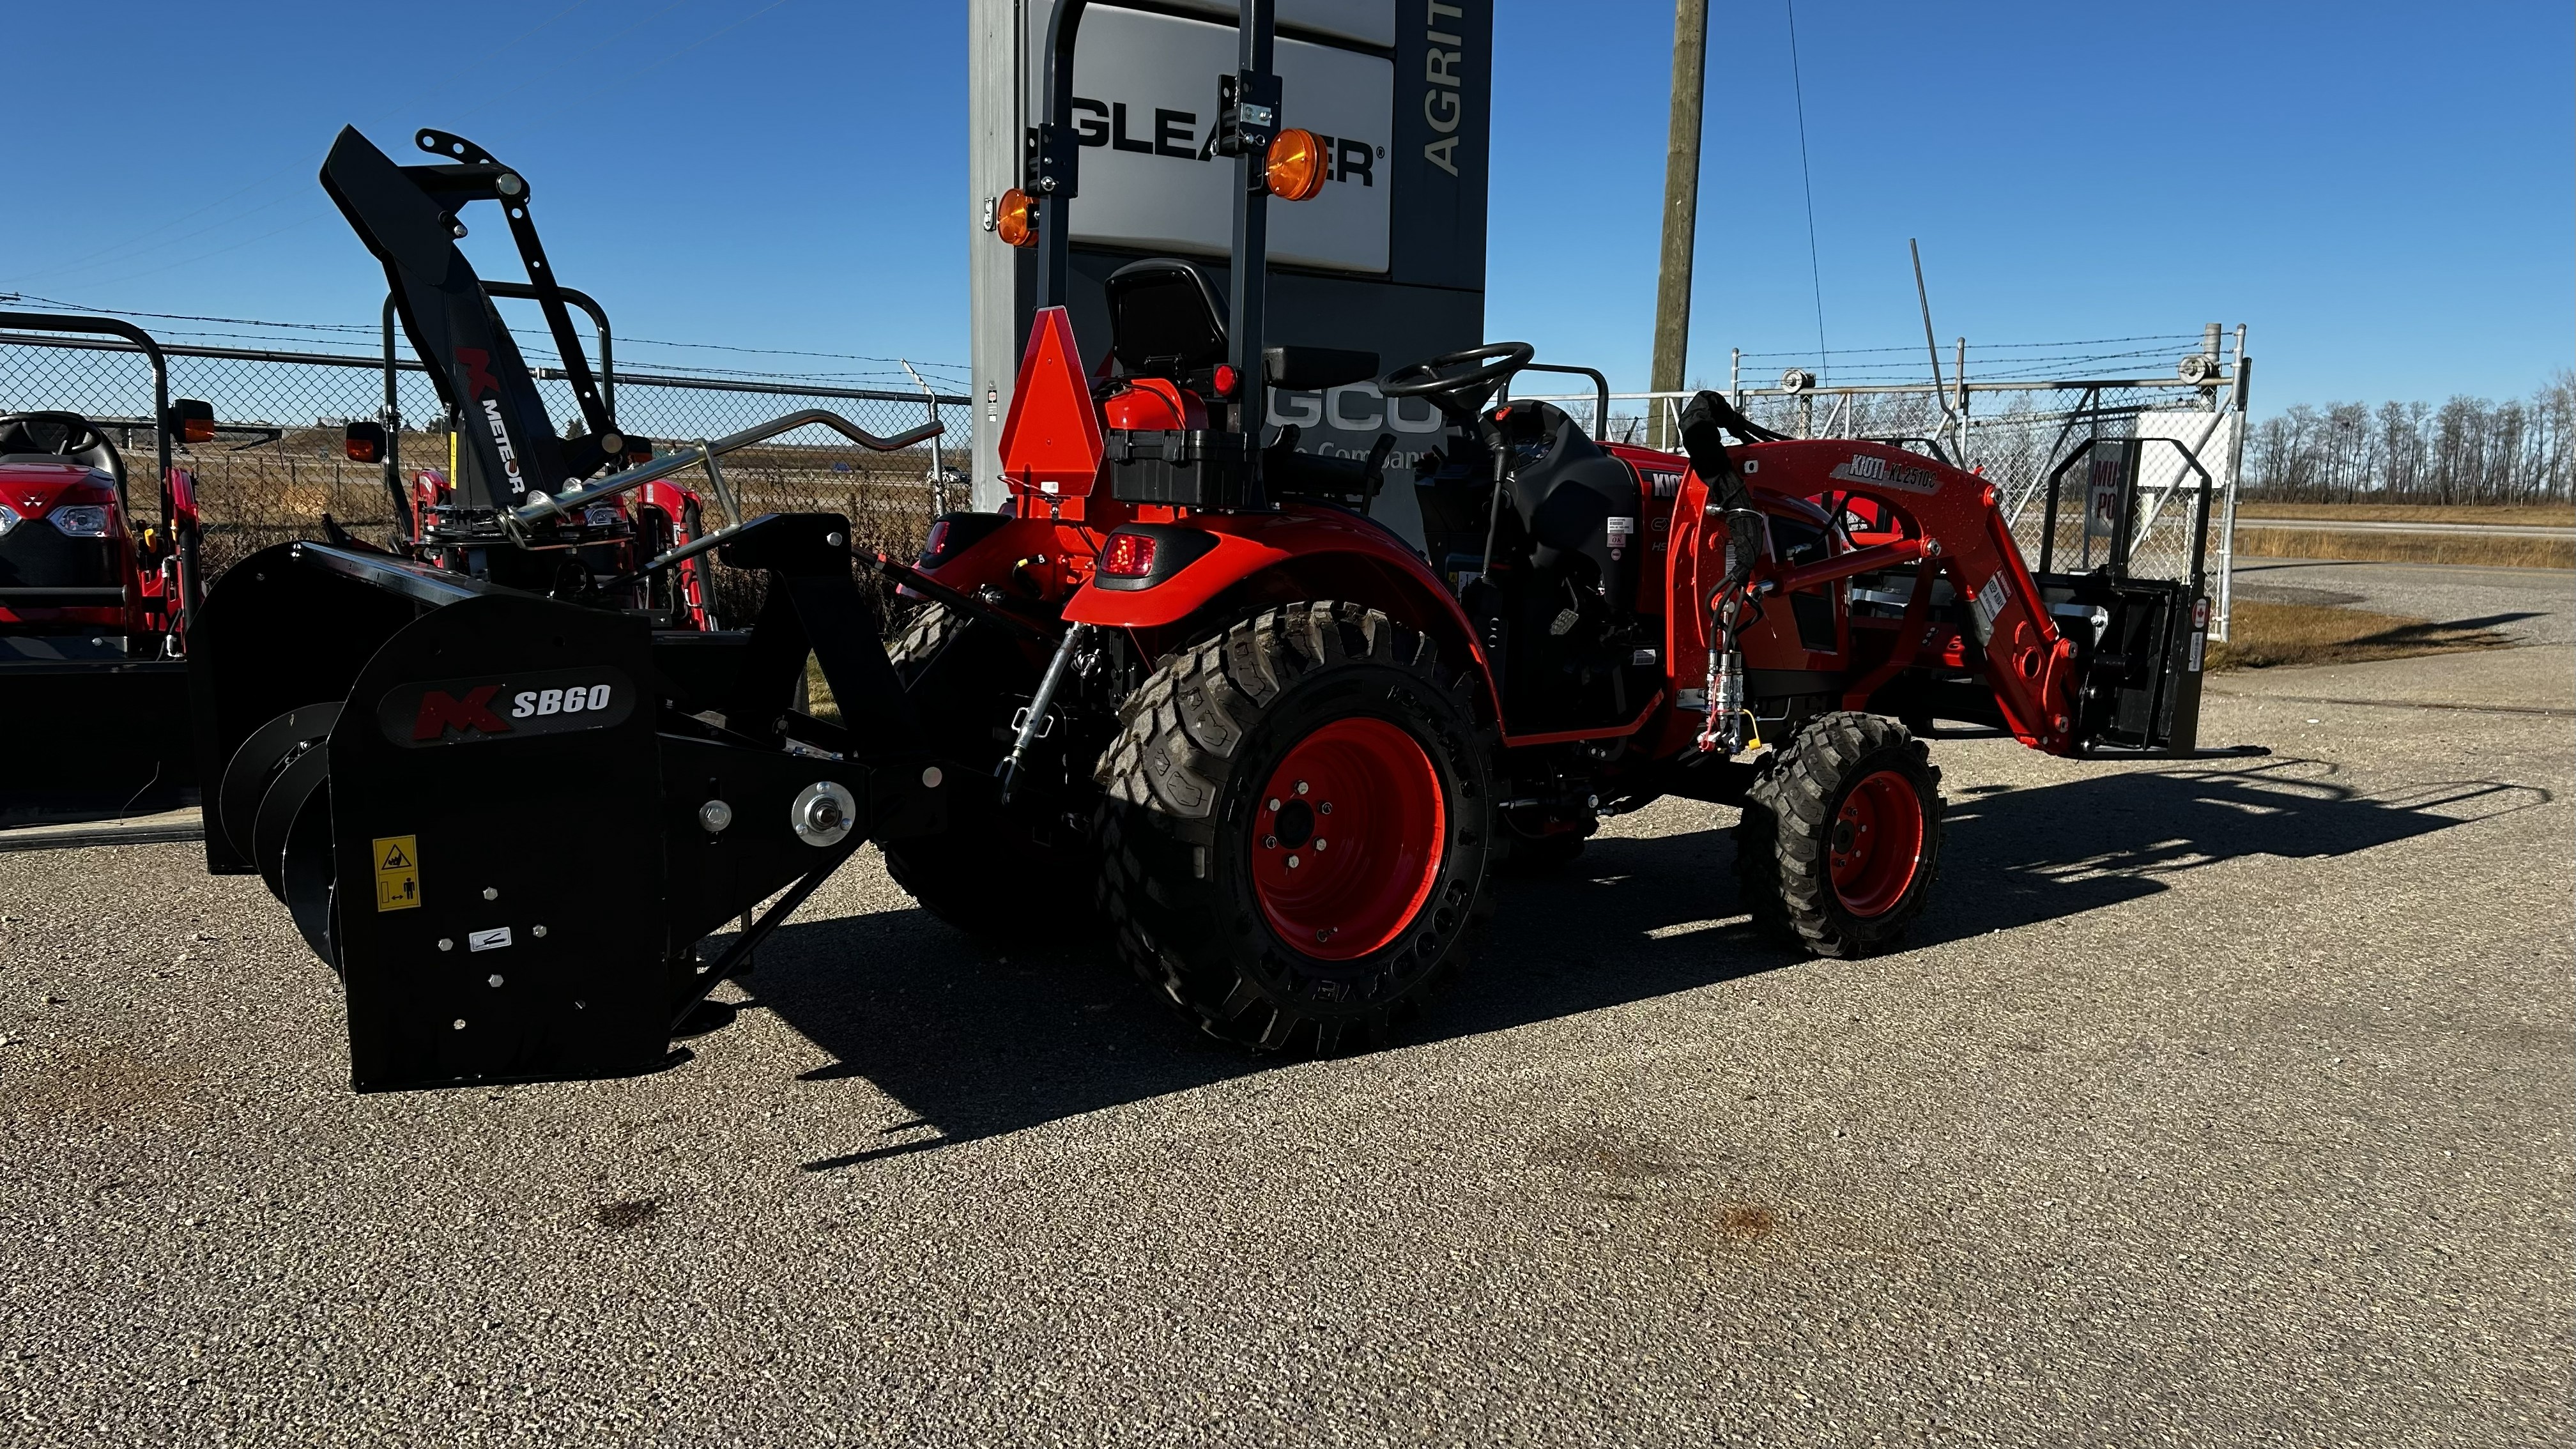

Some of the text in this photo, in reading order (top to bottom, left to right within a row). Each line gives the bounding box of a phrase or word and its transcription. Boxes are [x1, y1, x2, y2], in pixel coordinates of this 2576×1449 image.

[1425, 0, 1462, 177] AGRIT
[1265, 381, 1443, 433] GCO
[482, 399, 525, 494] METEOR
[1318, 442, 1427, 470] Coman
[1653, 473, 1683, 496] KIO
[1849, 454, 1937, 489] KIOTI KL2510C
[512, 684, 611, 717] SB60
